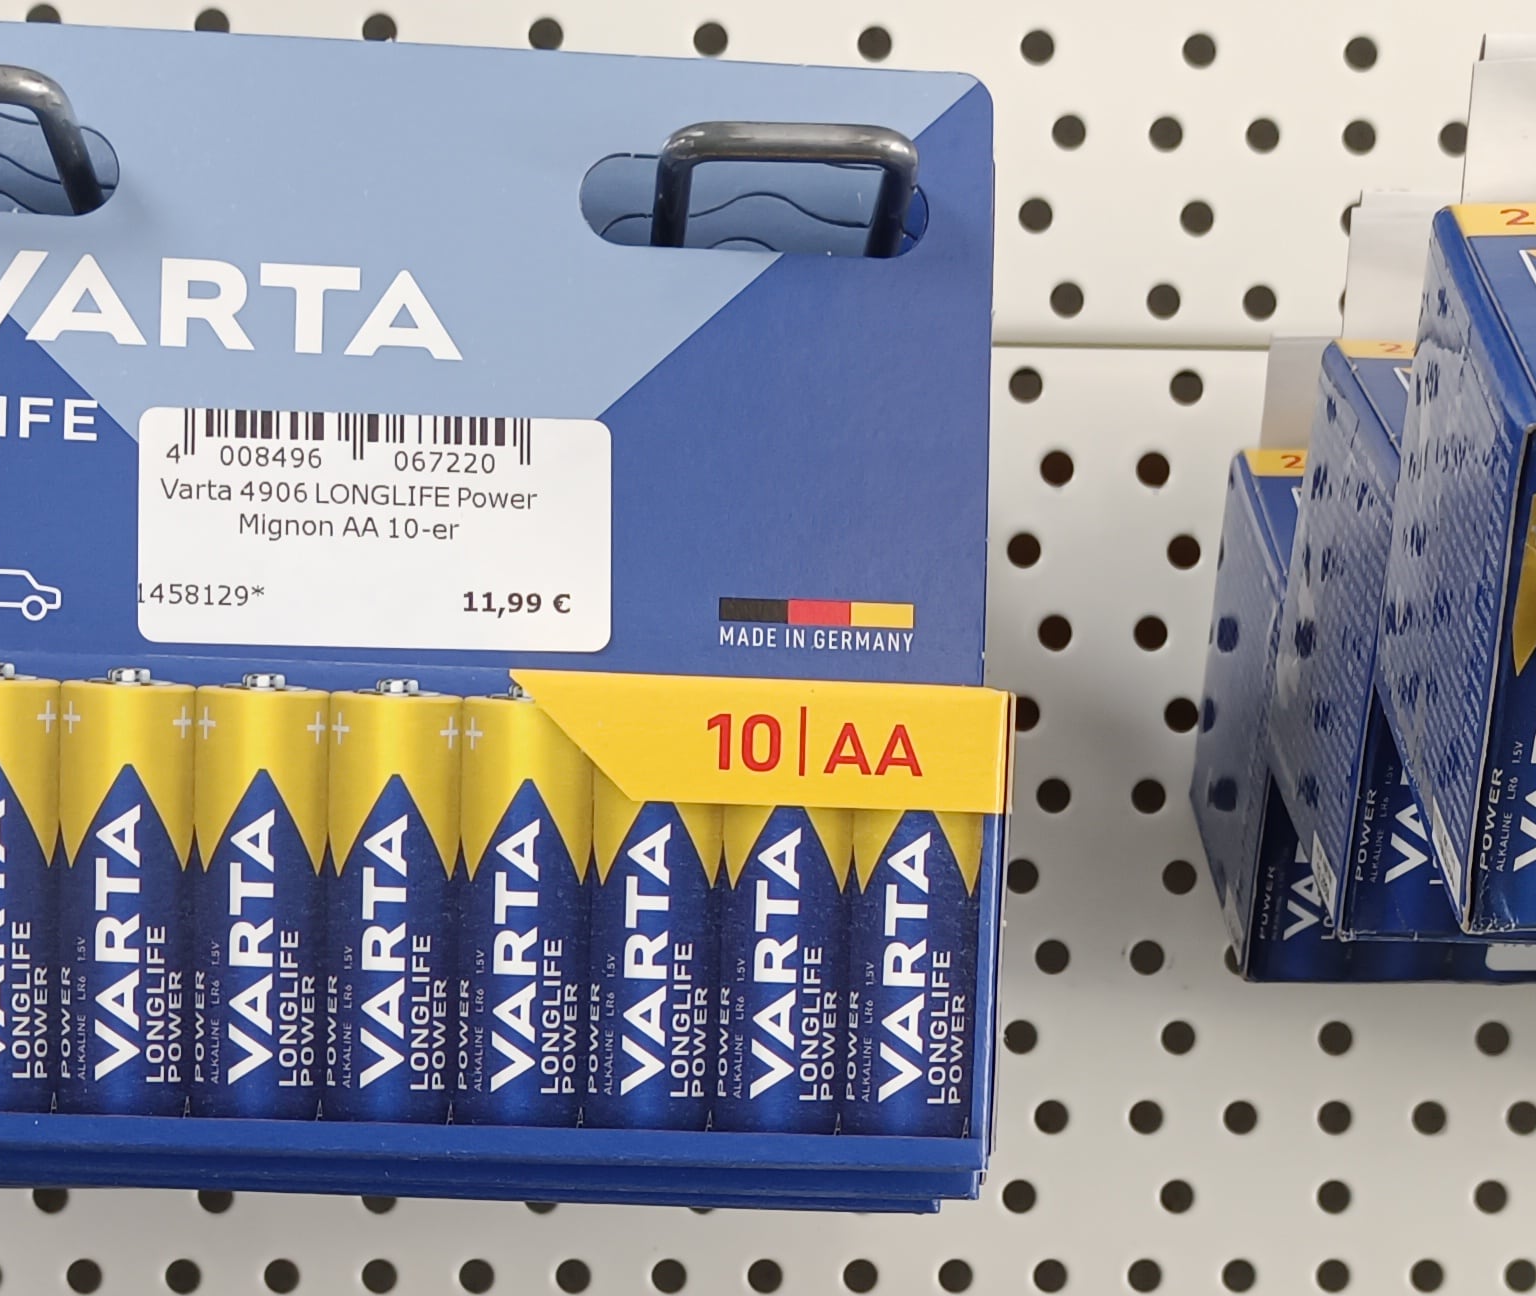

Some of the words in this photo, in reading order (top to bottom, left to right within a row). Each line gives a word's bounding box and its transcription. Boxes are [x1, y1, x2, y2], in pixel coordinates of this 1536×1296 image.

[219, 445, 323, 469] 008496
[393, 451, 496, 475] 067220
[160, 478, 233, 502] Varta
[240, 480, 308, 505] 4906
[315, 481, 450, 509] LONGLIFE
[457, 486, 538, 511] Power
[239, 514, 334, 542] Mignon
[342, 516, 379, 540] AA
[387, 517, 460, 541] 10-er
[463, 591, 543, 617] 11,99
[553, 593, 571, 614] €
[719, 626, 777, 649] MADE
[785, 628, 805, 650] IN
[813, 629, 914, 653] GERMANY
[94, 804, 141, 1081] VARTA
[146, 924, 167, 1083] LONGLIFE
